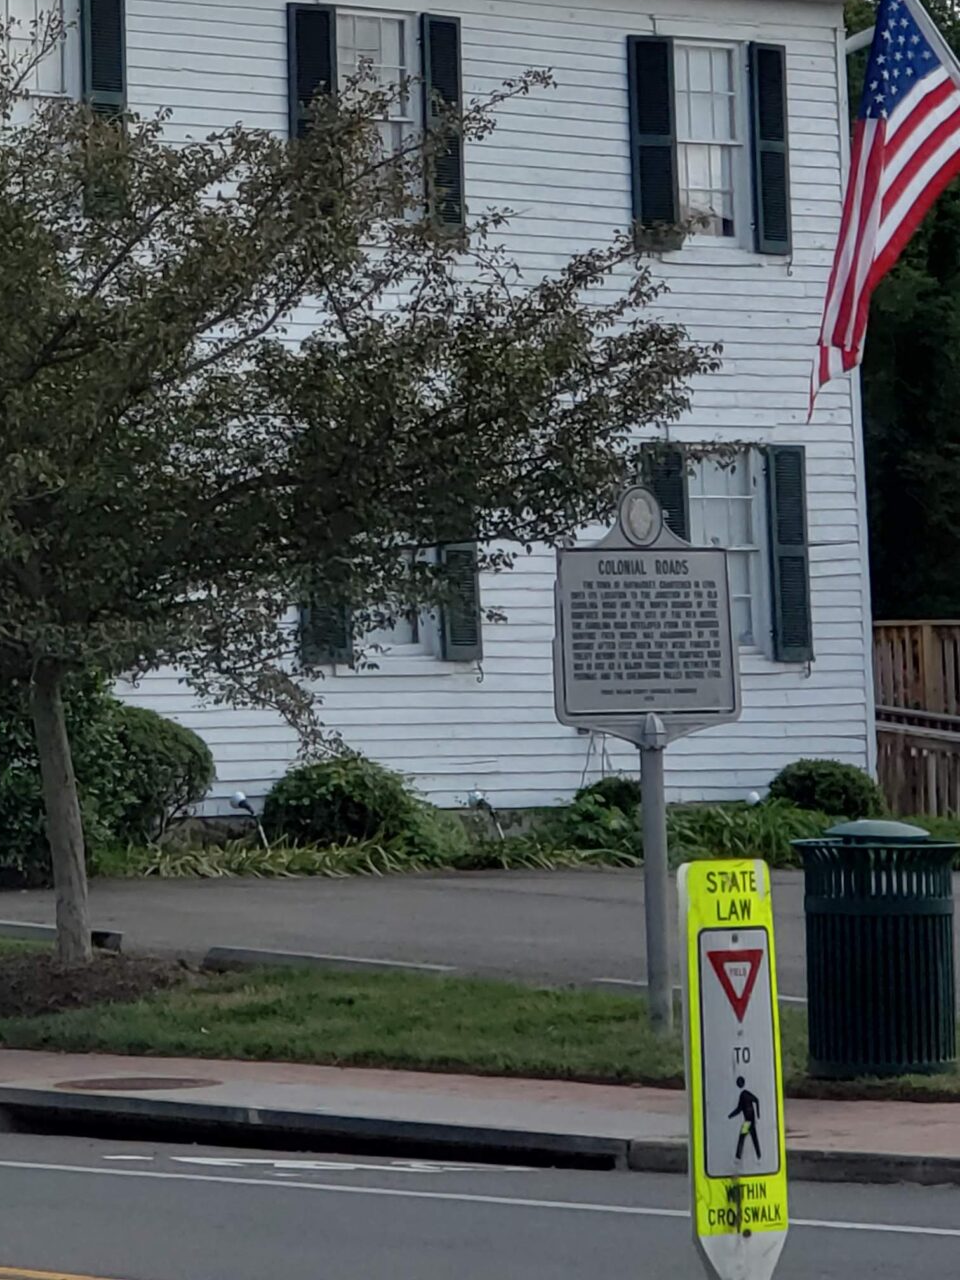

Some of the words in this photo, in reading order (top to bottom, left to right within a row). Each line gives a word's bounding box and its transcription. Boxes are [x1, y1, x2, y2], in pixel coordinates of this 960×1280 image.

[599, 560, 647, 575] COLONIAL
[656, 560, 689, 575] ROADS
[706, 871, 757, 893] STATE
[717, 899, 751, 921] LAW
[728, 967, 747, 977] YIELD
[734, 1047, 750, 1064] TO
[707, 1204, 781, 1226] CROSWALK
